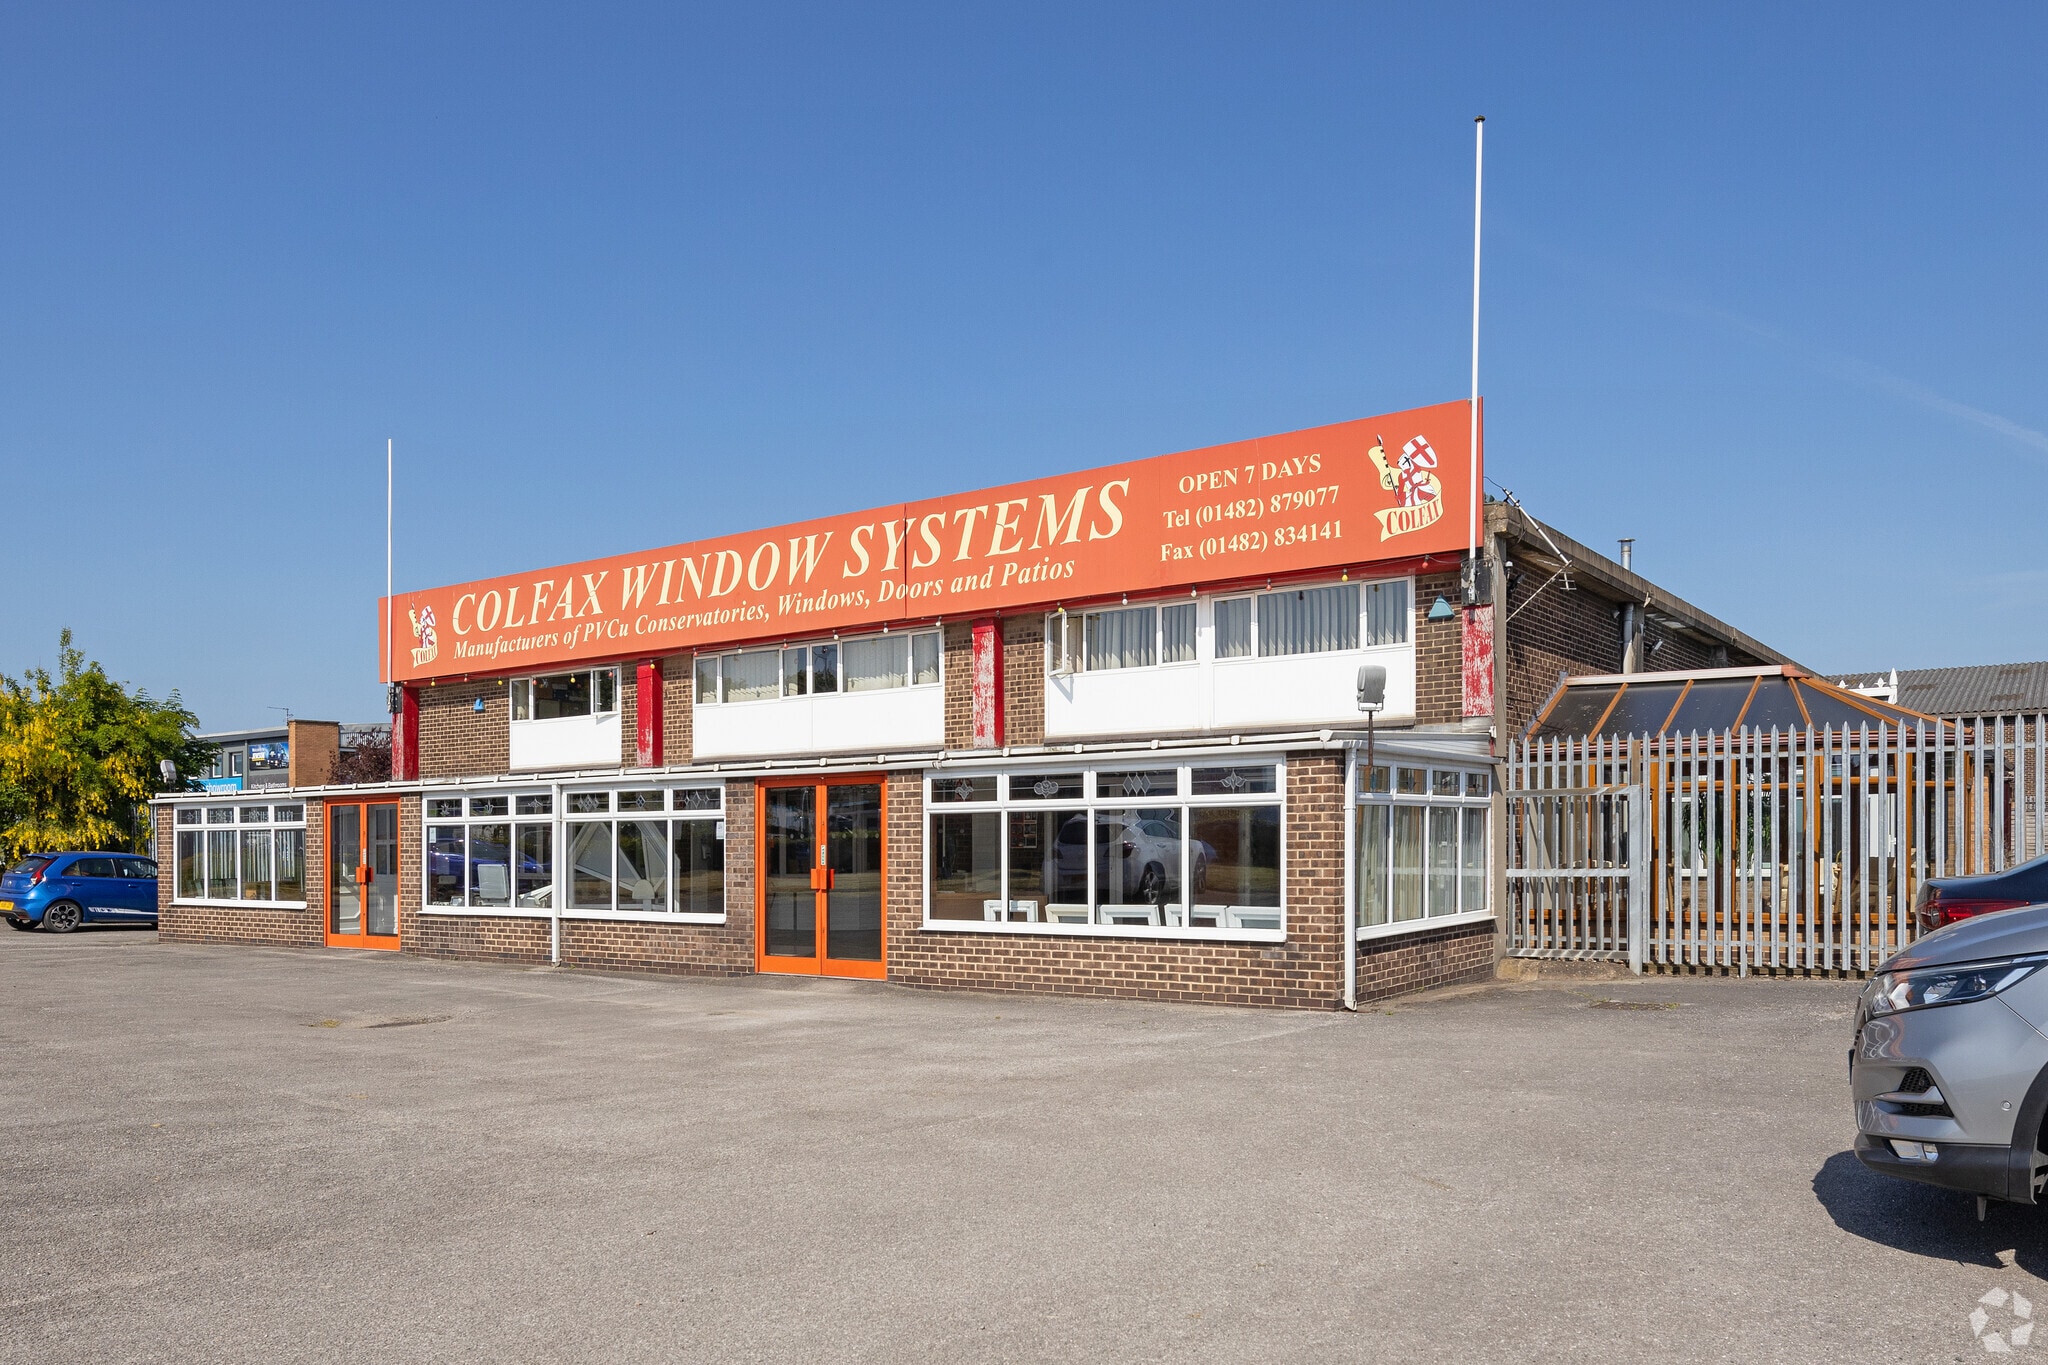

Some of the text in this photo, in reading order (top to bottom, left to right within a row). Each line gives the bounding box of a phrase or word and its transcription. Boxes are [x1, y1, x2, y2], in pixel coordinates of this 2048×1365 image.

[1178, 453, 1322, 494] OPEN 7 DAYS
[1162, 485, 1340, 529] Tel (01482) 879077
[453, 477, 1131, 636] COLFAX WINDOW SYSTEMS
[1160, 520, 1343, 562] Fax (01482) 834141
[453, 556, 1075, 660] Manufacturers of PVCu Conservatories, Windows, Doors and Patios
